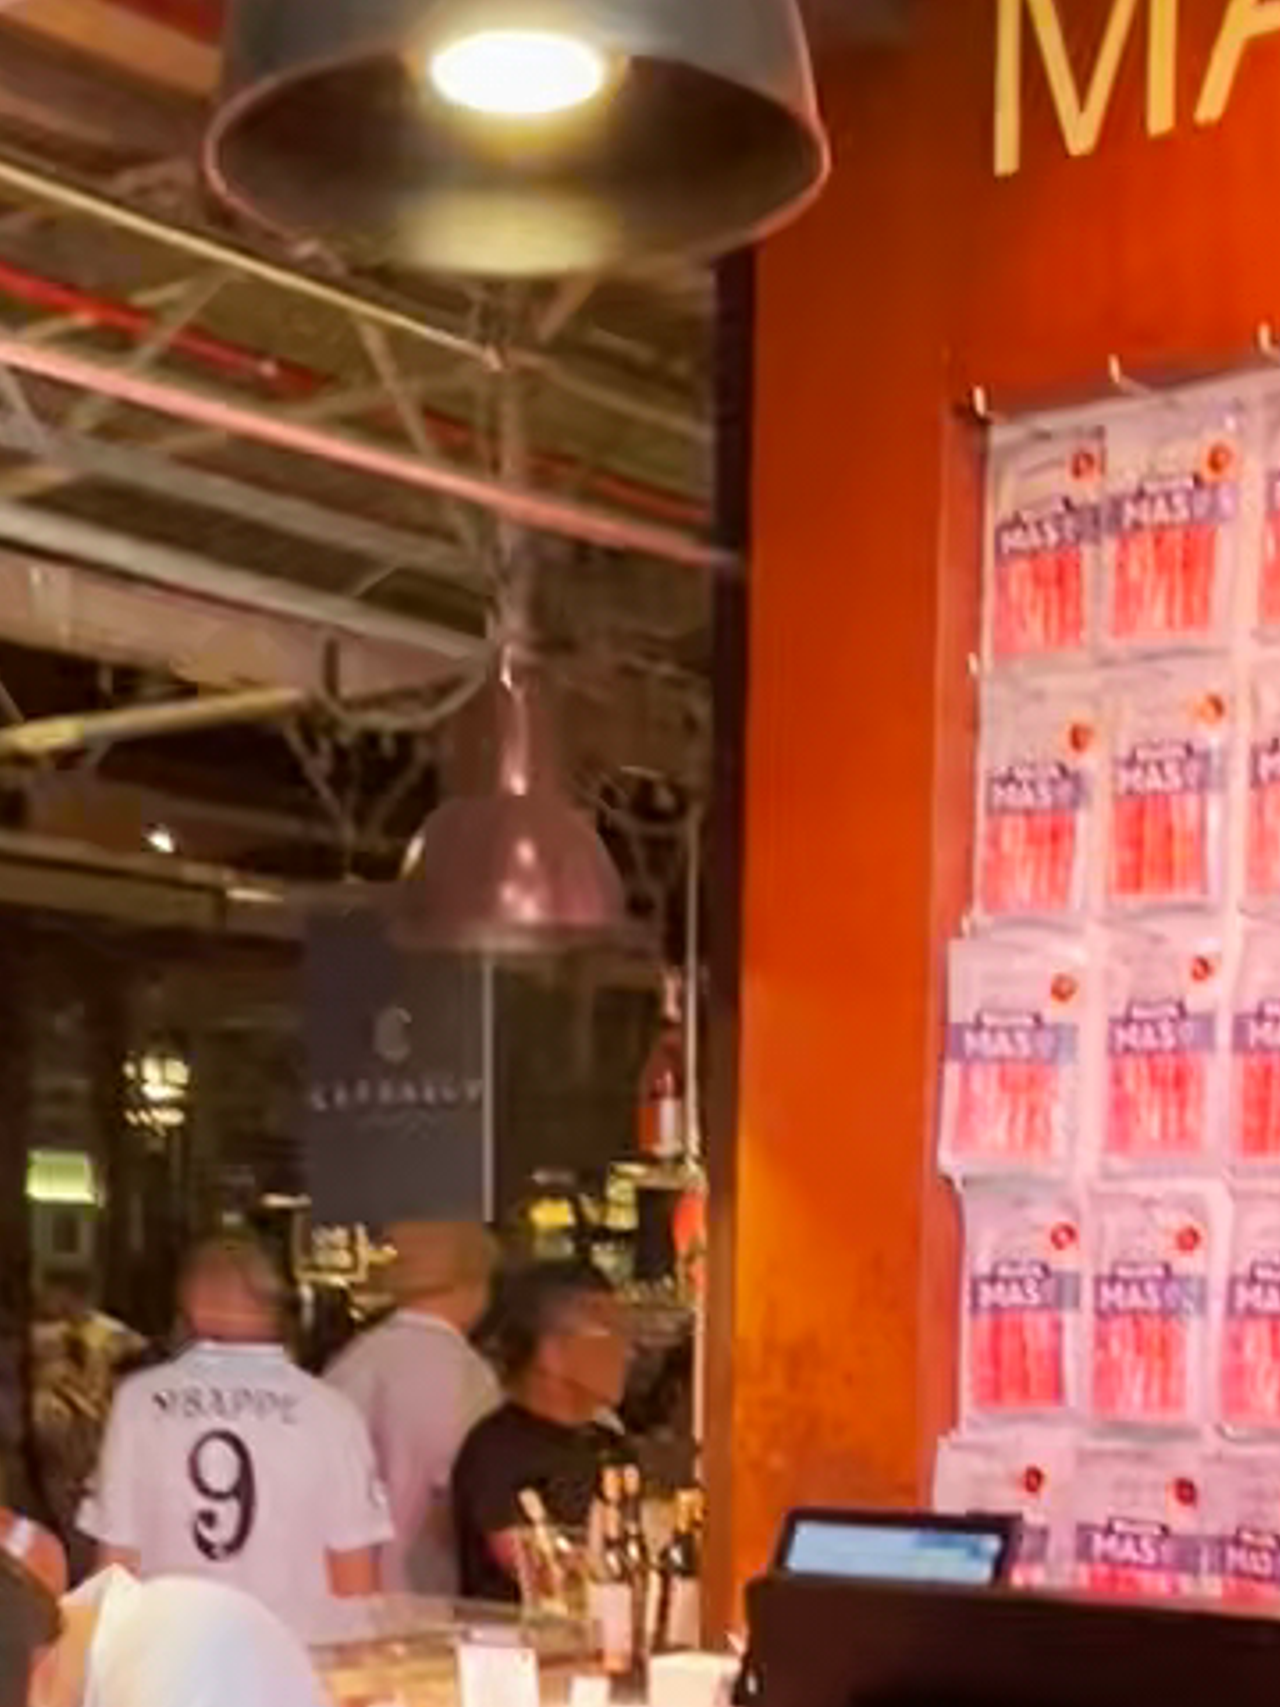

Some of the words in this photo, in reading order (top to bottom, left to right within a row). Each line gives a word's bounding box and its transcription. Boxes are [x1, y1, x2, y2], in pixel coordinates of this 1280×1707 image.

[964, 1027, 1031, 1055] MAS
[1117, 1020, 1176, 1051] MAS
[979, 1281, 1040, 1307] MAS
[1100, 1282, 1158, 1311] MAS
[187, 1430, 258, 1561] 9
[1094, 1535, 1154, 1564] MAS
